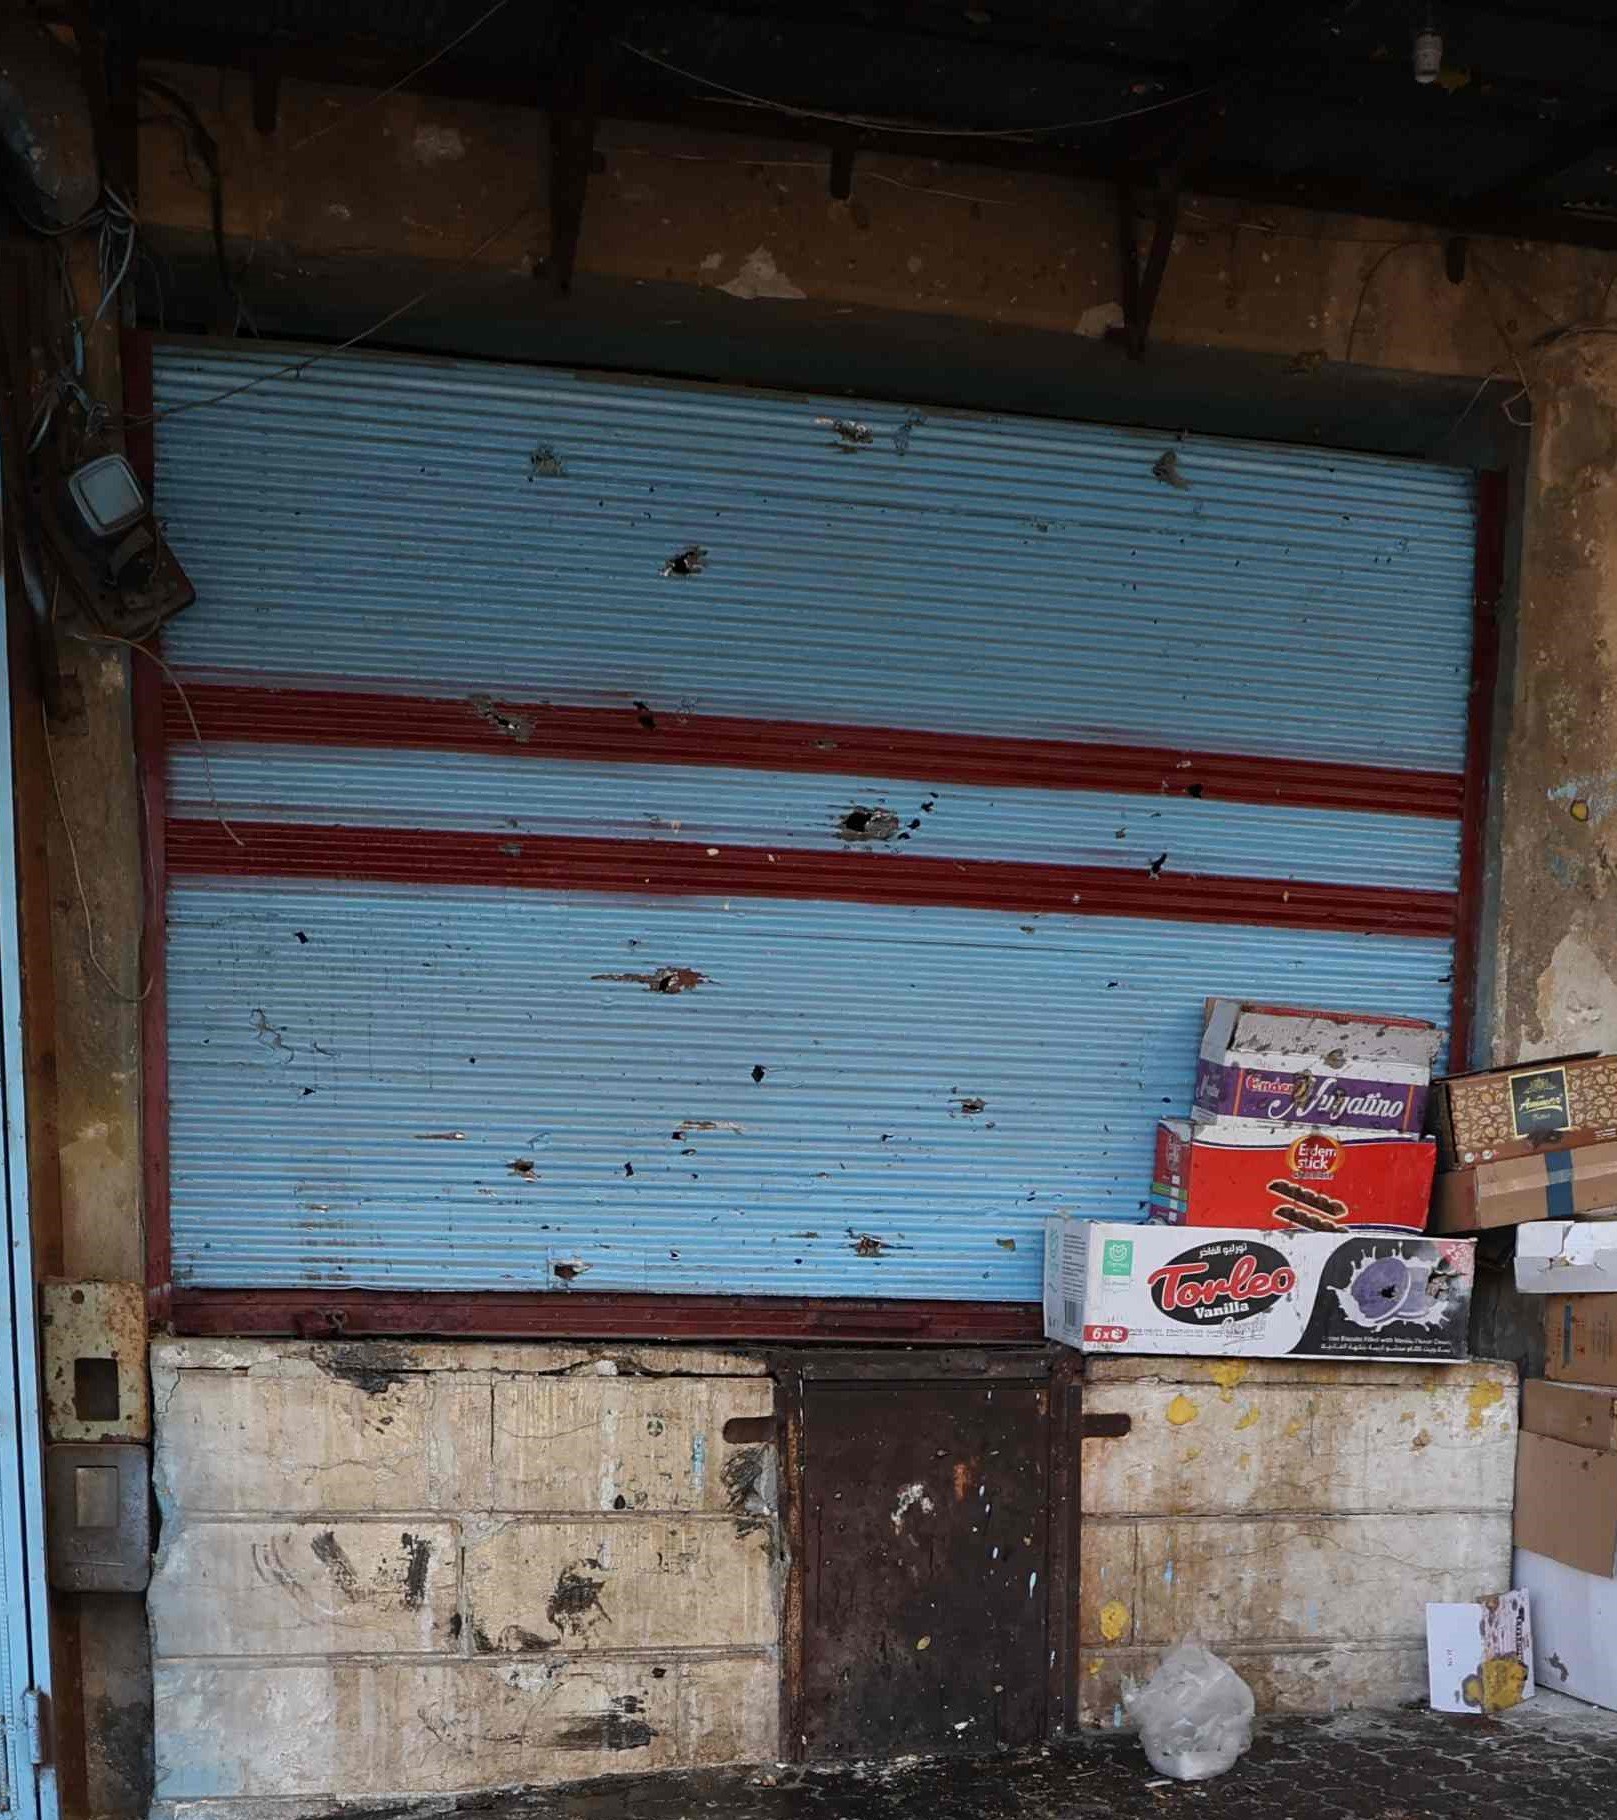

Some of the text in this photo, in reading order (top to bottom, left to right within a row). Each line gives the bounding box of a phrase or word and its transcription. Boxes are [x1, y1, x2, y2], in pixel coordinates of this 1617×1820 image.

[1268, 1074, 1404, 1120] Nugatino
[1298, 1143, 1337, 1159] Erdem
[1297, 1157, 1329, 1171] stick
[1147, 1255, 1296, 1310] Torleo
[1194, 1301, 1250, 1320] Vanilla
